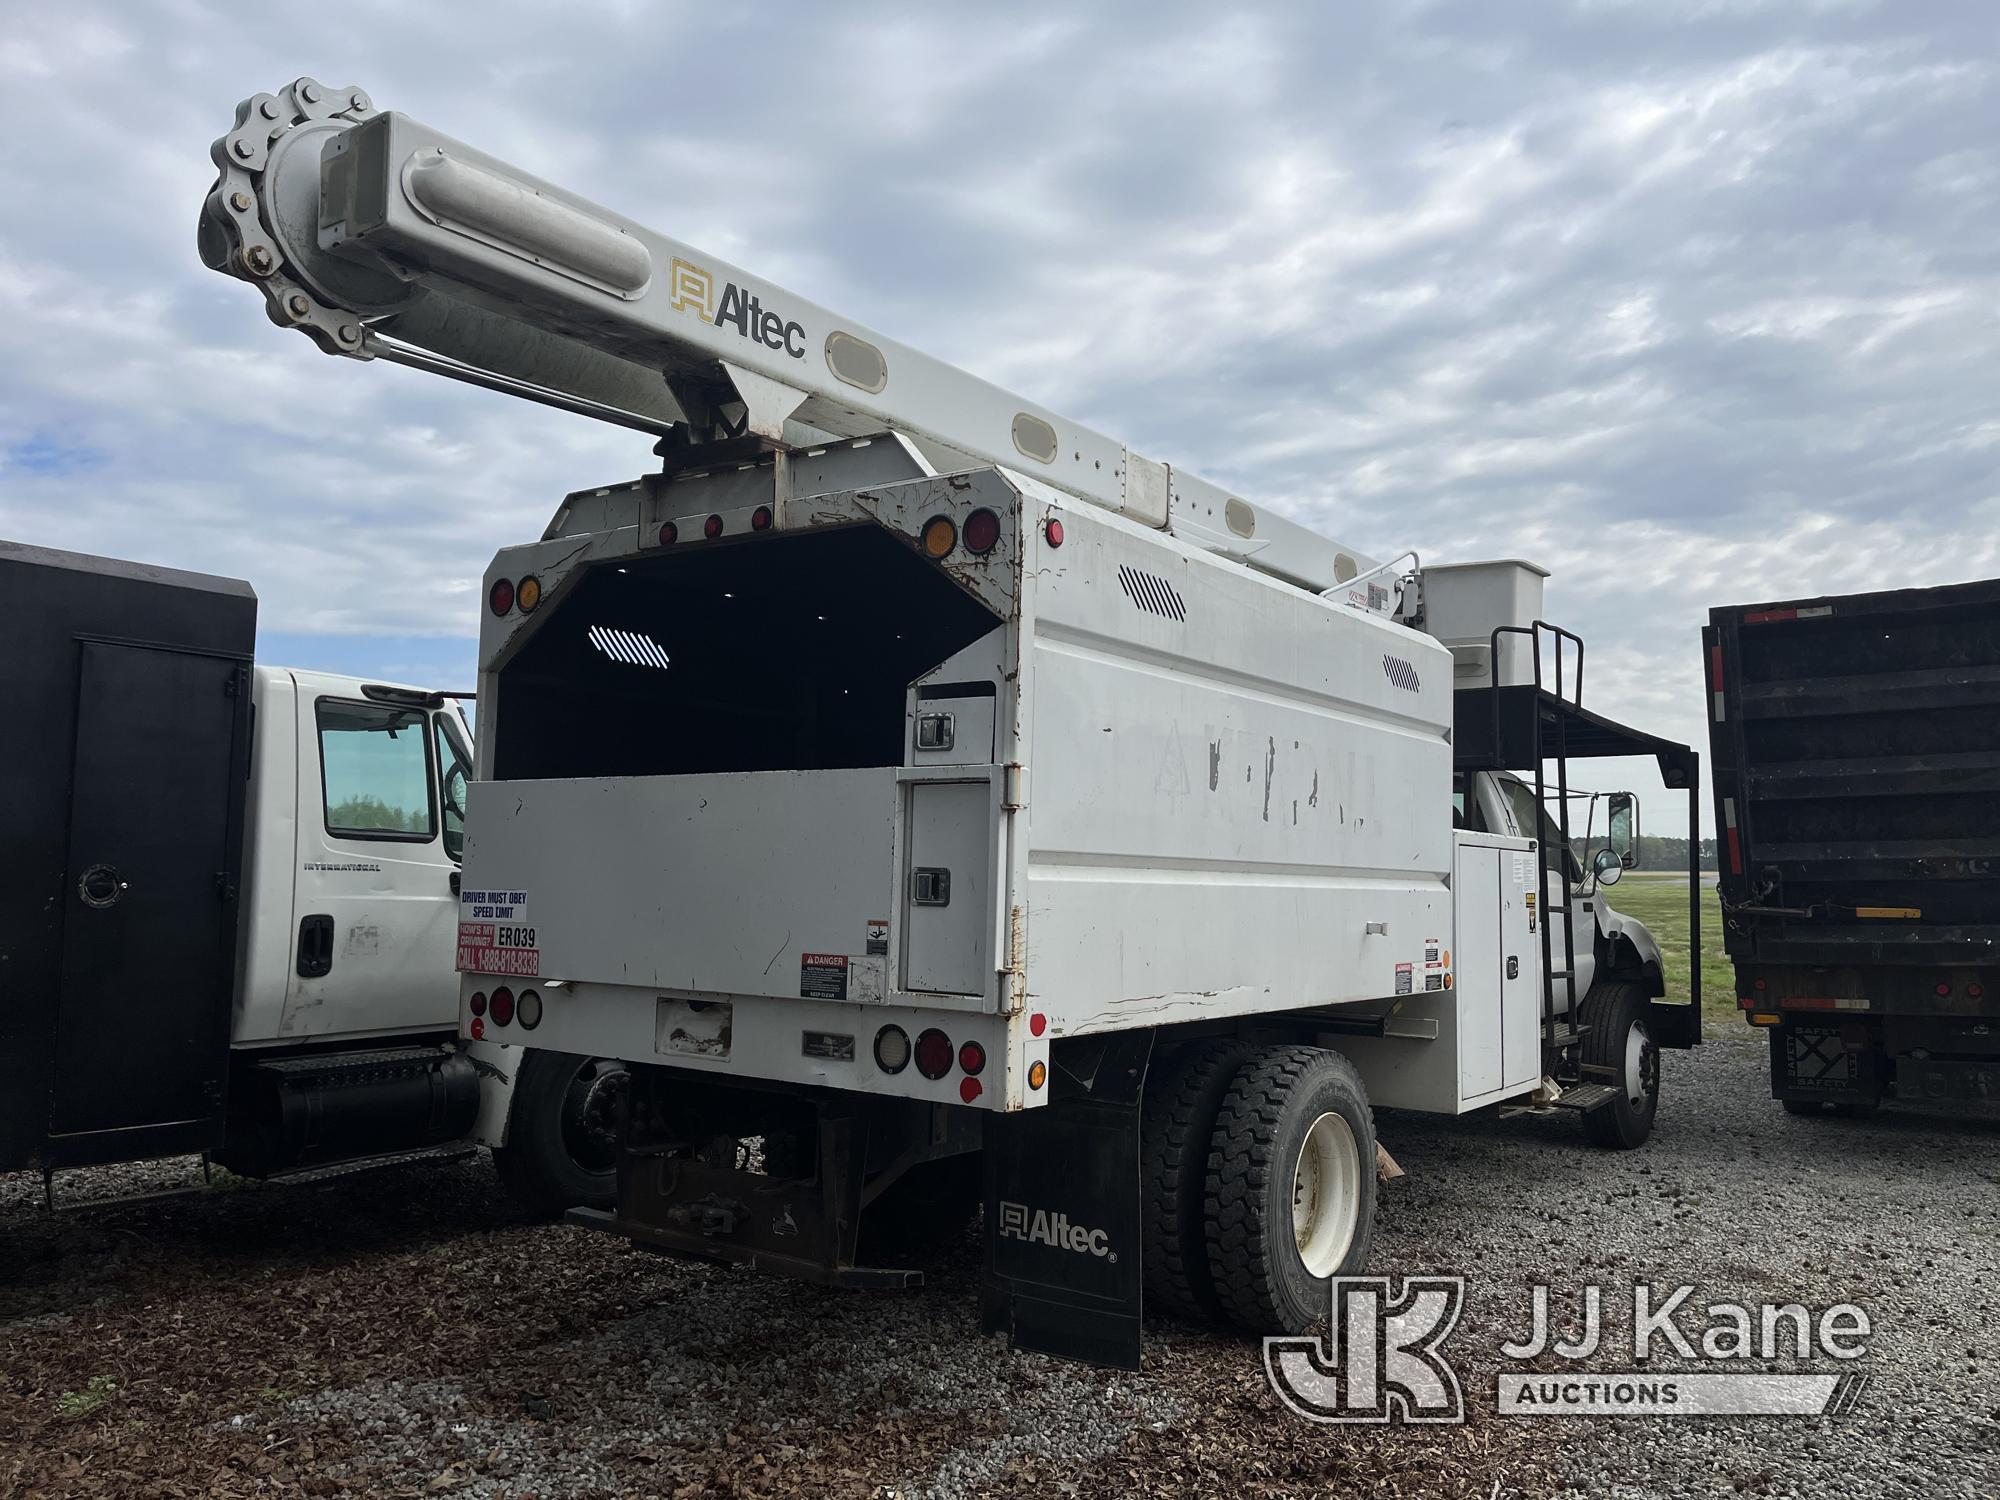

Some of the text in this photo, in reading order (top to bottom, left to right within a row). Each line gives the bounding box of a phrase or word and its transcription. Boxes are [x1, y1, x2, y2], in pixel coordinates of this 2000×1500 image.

[714, 282, 806, 359] Altec
[304, 863, 381, 872] INTERNATIONAL
[462, 891, 527, 905] DRIVER MUST OBEY
[473, 906, 515, 920] SPEED LIMIT
[482, 925, 494, 937] MY
[498, 926, 536, 948] ER039
[457, 947, 476, 970] CALL
[814, 956, 843, 967] DANGER
[1795, 1027, 1841, 1035] SAFET
[1797, 1079, 1848, 1087] SAFETY
[1028, 1208, 1109, 1258] Altec
